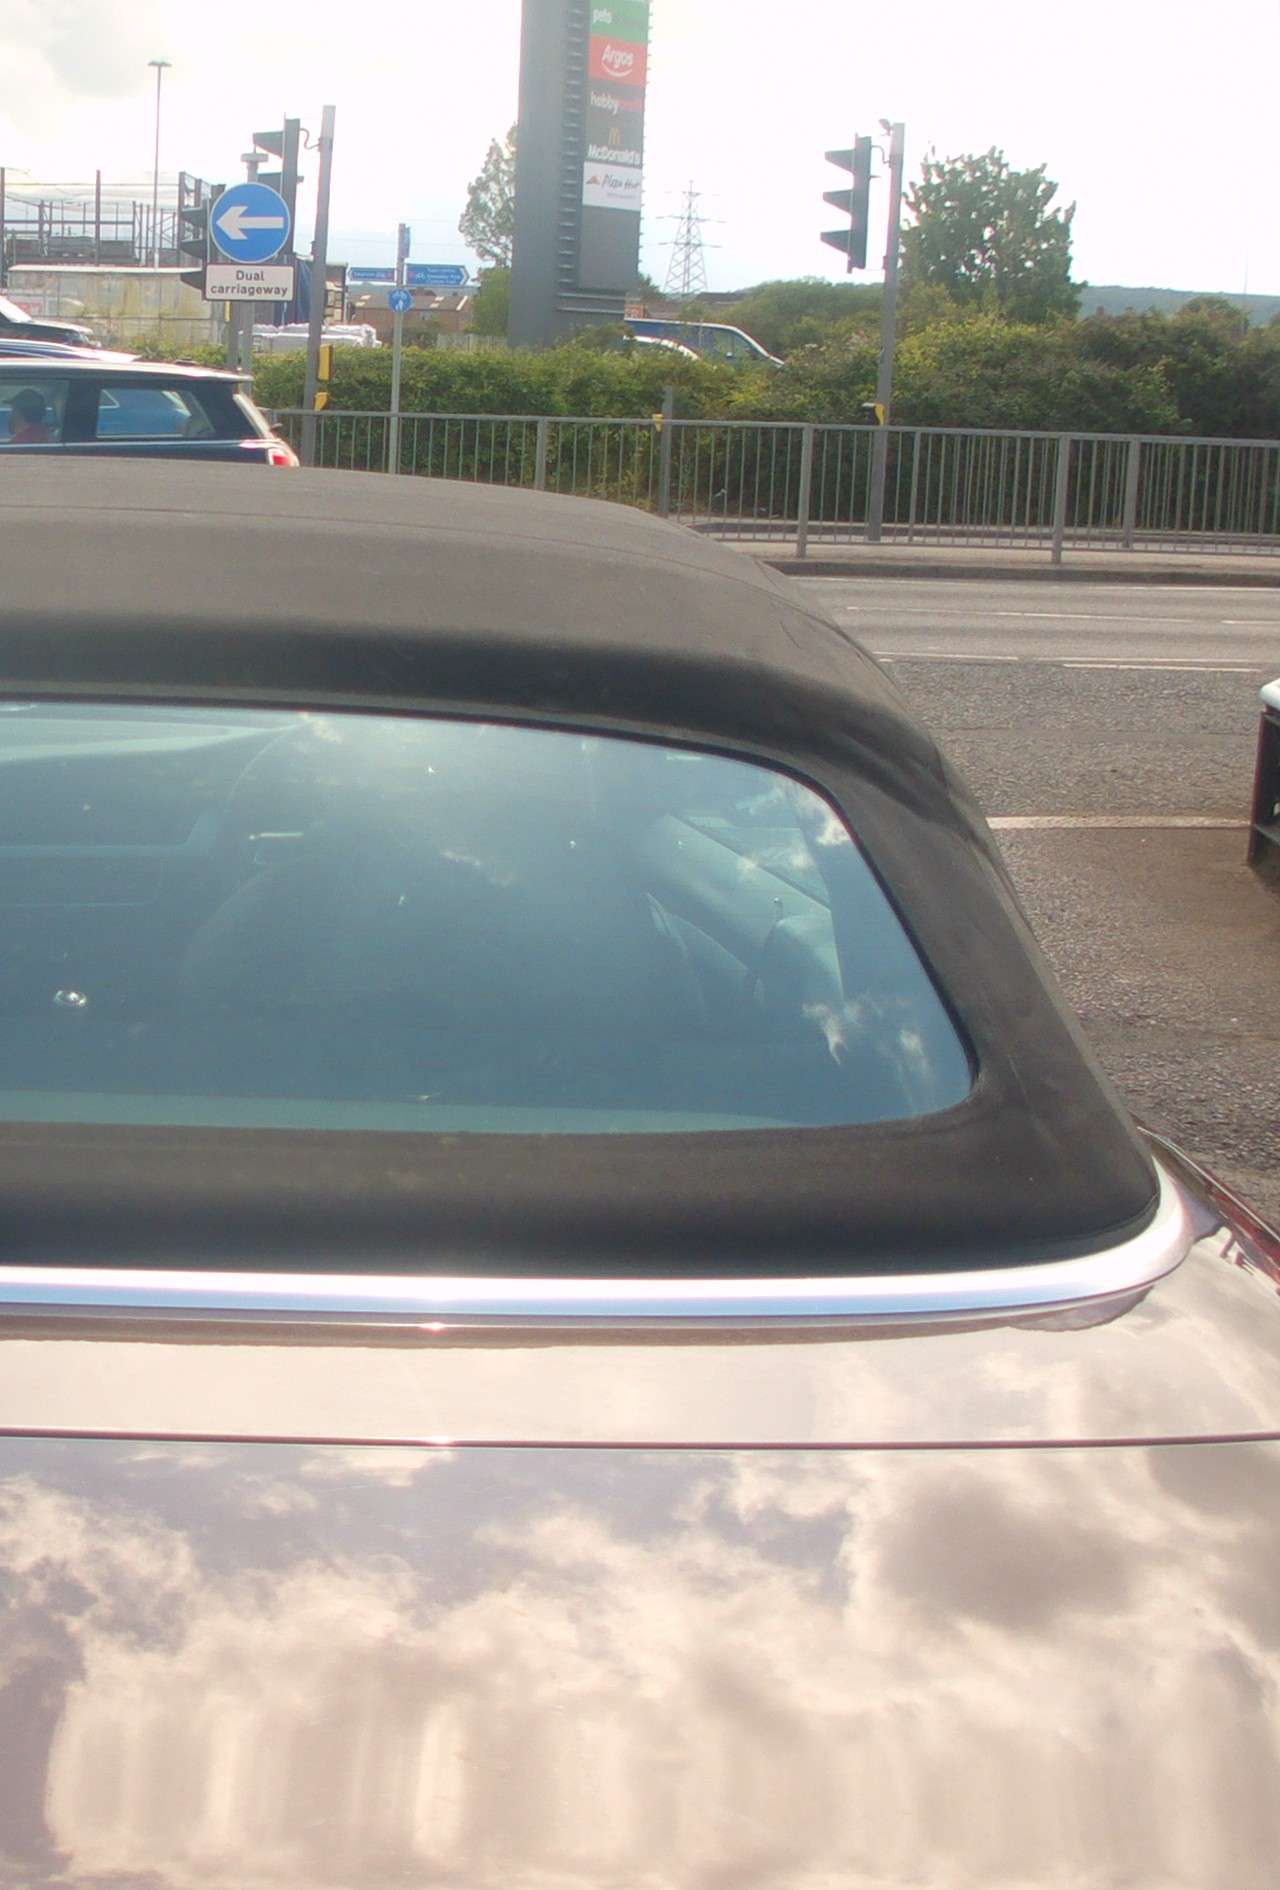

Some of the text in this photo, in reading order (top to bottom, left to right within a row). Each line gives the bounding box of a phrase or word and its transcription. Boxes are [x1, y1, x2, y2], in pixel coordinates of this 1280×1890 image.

[601, 44, 634, 69] Argos
[235, 270, 265, 281] Dual
[210, 283, 288, 298] carriageway
